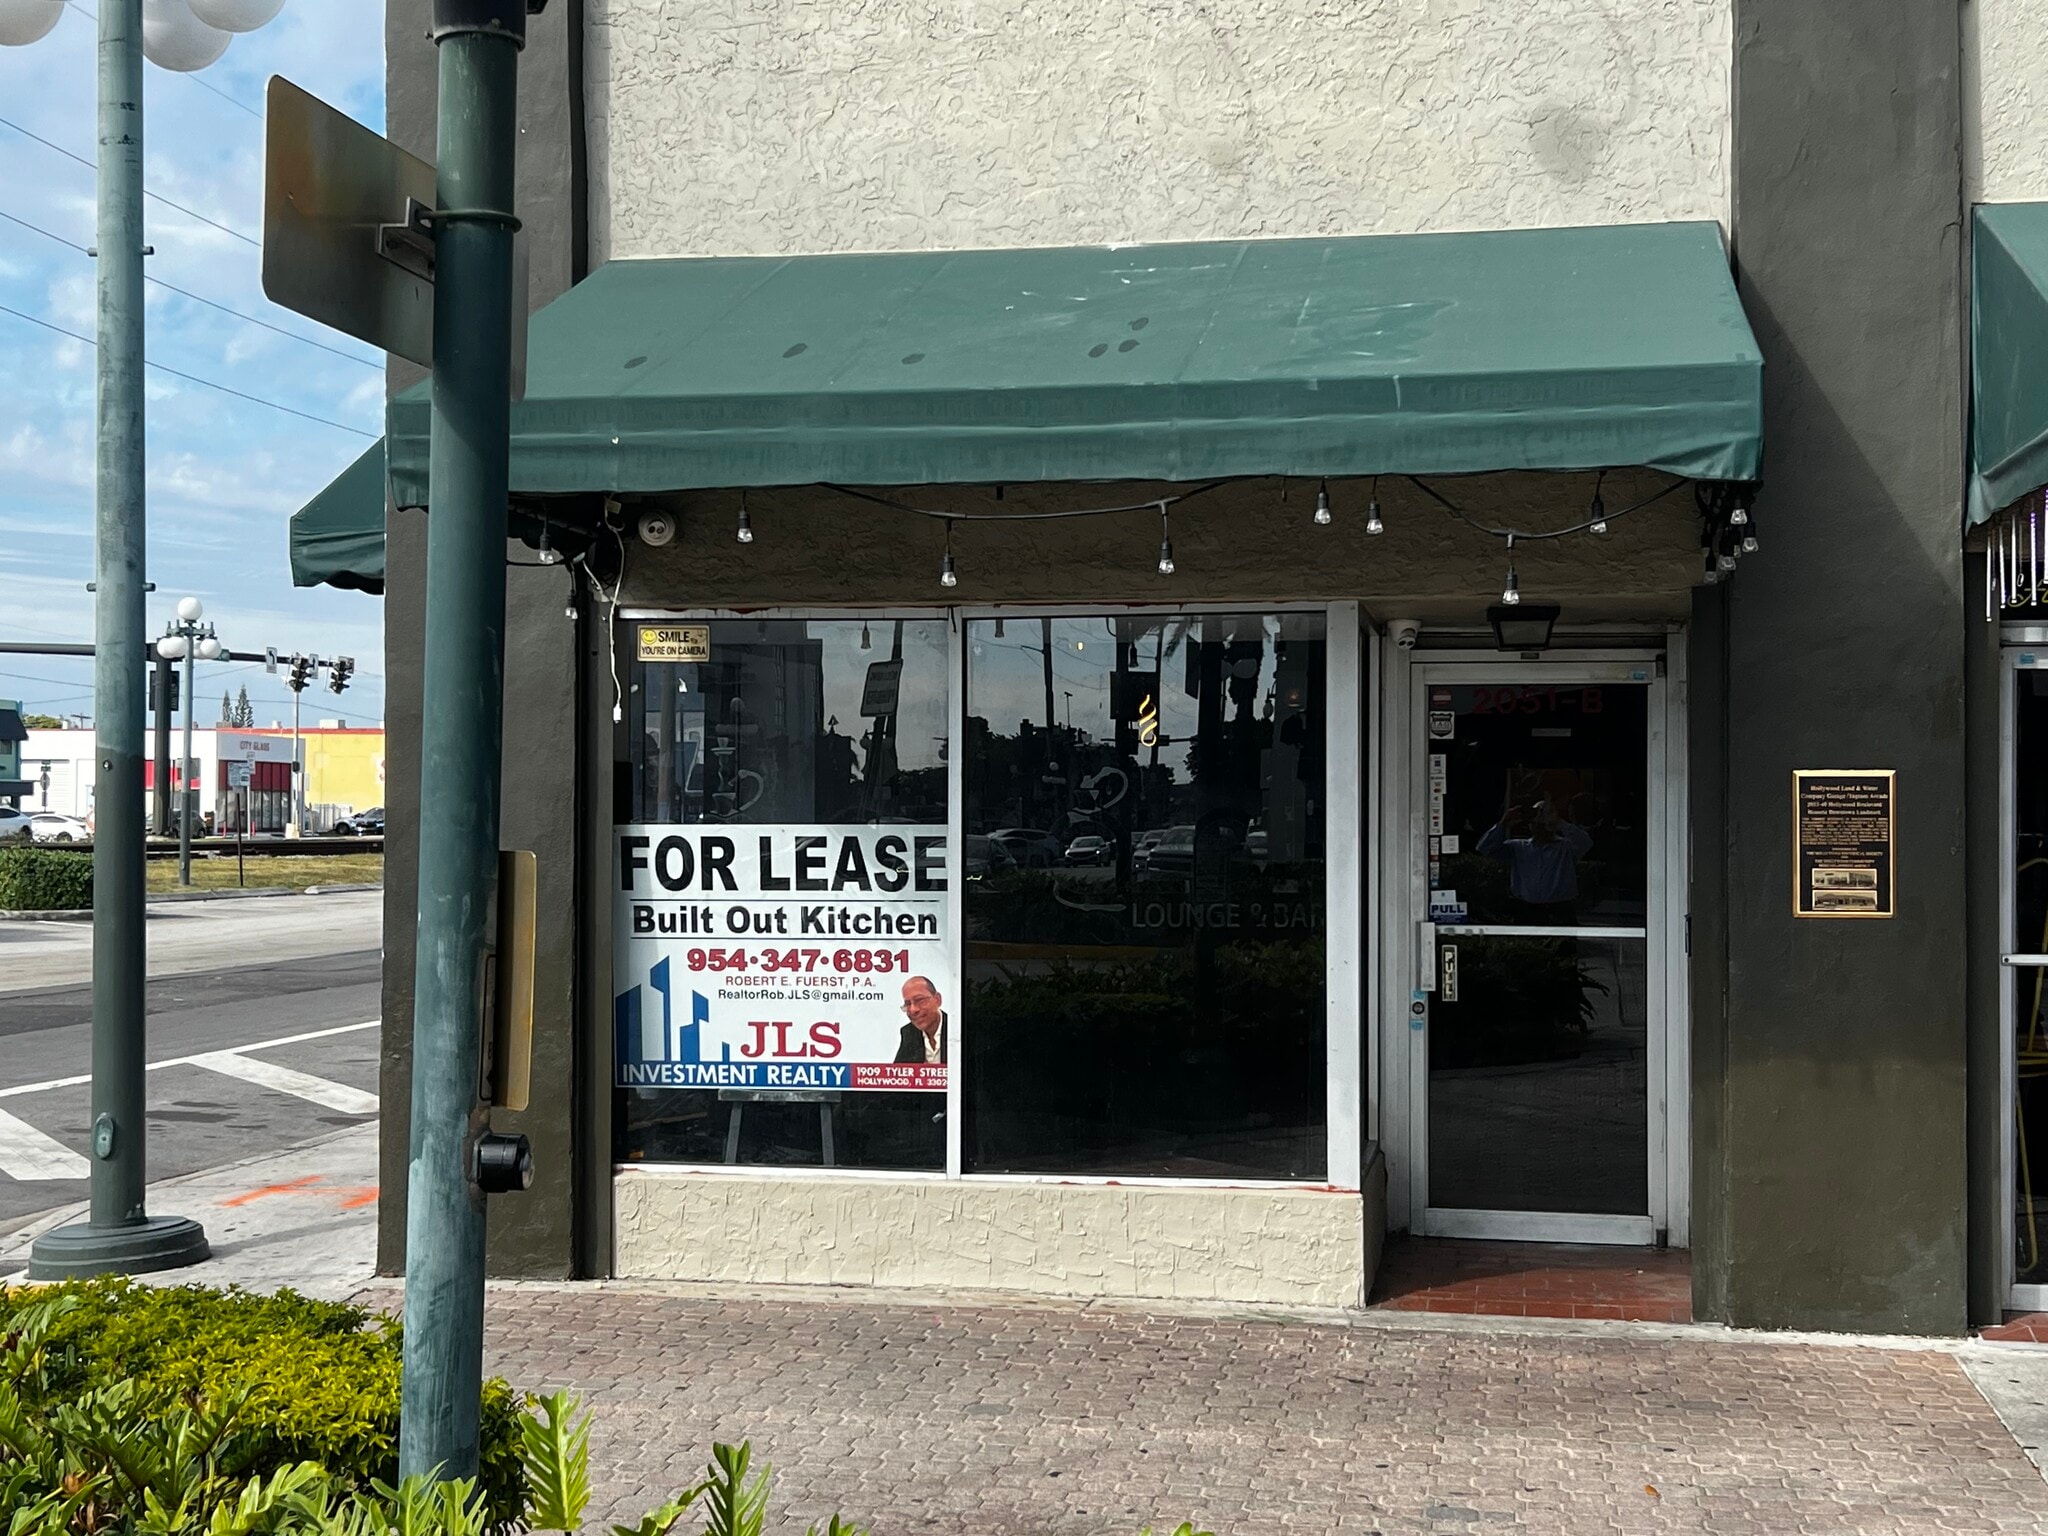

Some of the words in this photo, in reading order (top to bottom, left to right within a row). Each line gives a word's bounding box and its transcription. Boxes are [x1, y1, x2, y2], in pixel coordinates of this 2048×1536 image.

[658, 631, 690, 643] SMILE
[641, 646, 665, 655] YOU'RE
[666, 646, 677, 655] ON
[678, 646, 706, 655] CAMERA
[1472, 687, 1605, 714] 2051-B
[240, 740, 252, 750] CITY
[621, 835, 738, 892] FOR
[760, 836, 947, 892] LEASE
[1132, 903, 1240, 928] LOUNGE
[1432, 905, 1464, 914] PULL
[633, 906, 713, 934] Built
[726, 906, 787, 934] Out
[801, 906, 937, 935] Kitchen
[1444, 951, 1454, 995] PULL
[725, 976, 776, 987] ROBERT
[781, 976, 791, 987] E.
[796, 976, 849, 989] FUERST,
[852, 976, 876, 988] P.A.
[718, 989, 884, 1002] RealtorRob.JLS@gmail.com
[740, 1021, 842, 1058] JLS
[623, 1064, 756, 1084] INVESTMENT
[767, 1065, 845, 1085] REALTY
[856, 1067, 881, 1077] 1909
[886, 1067, 914, 1077] TYLER
[857, 1078, 911, 1086] HOLLYWOOD,
